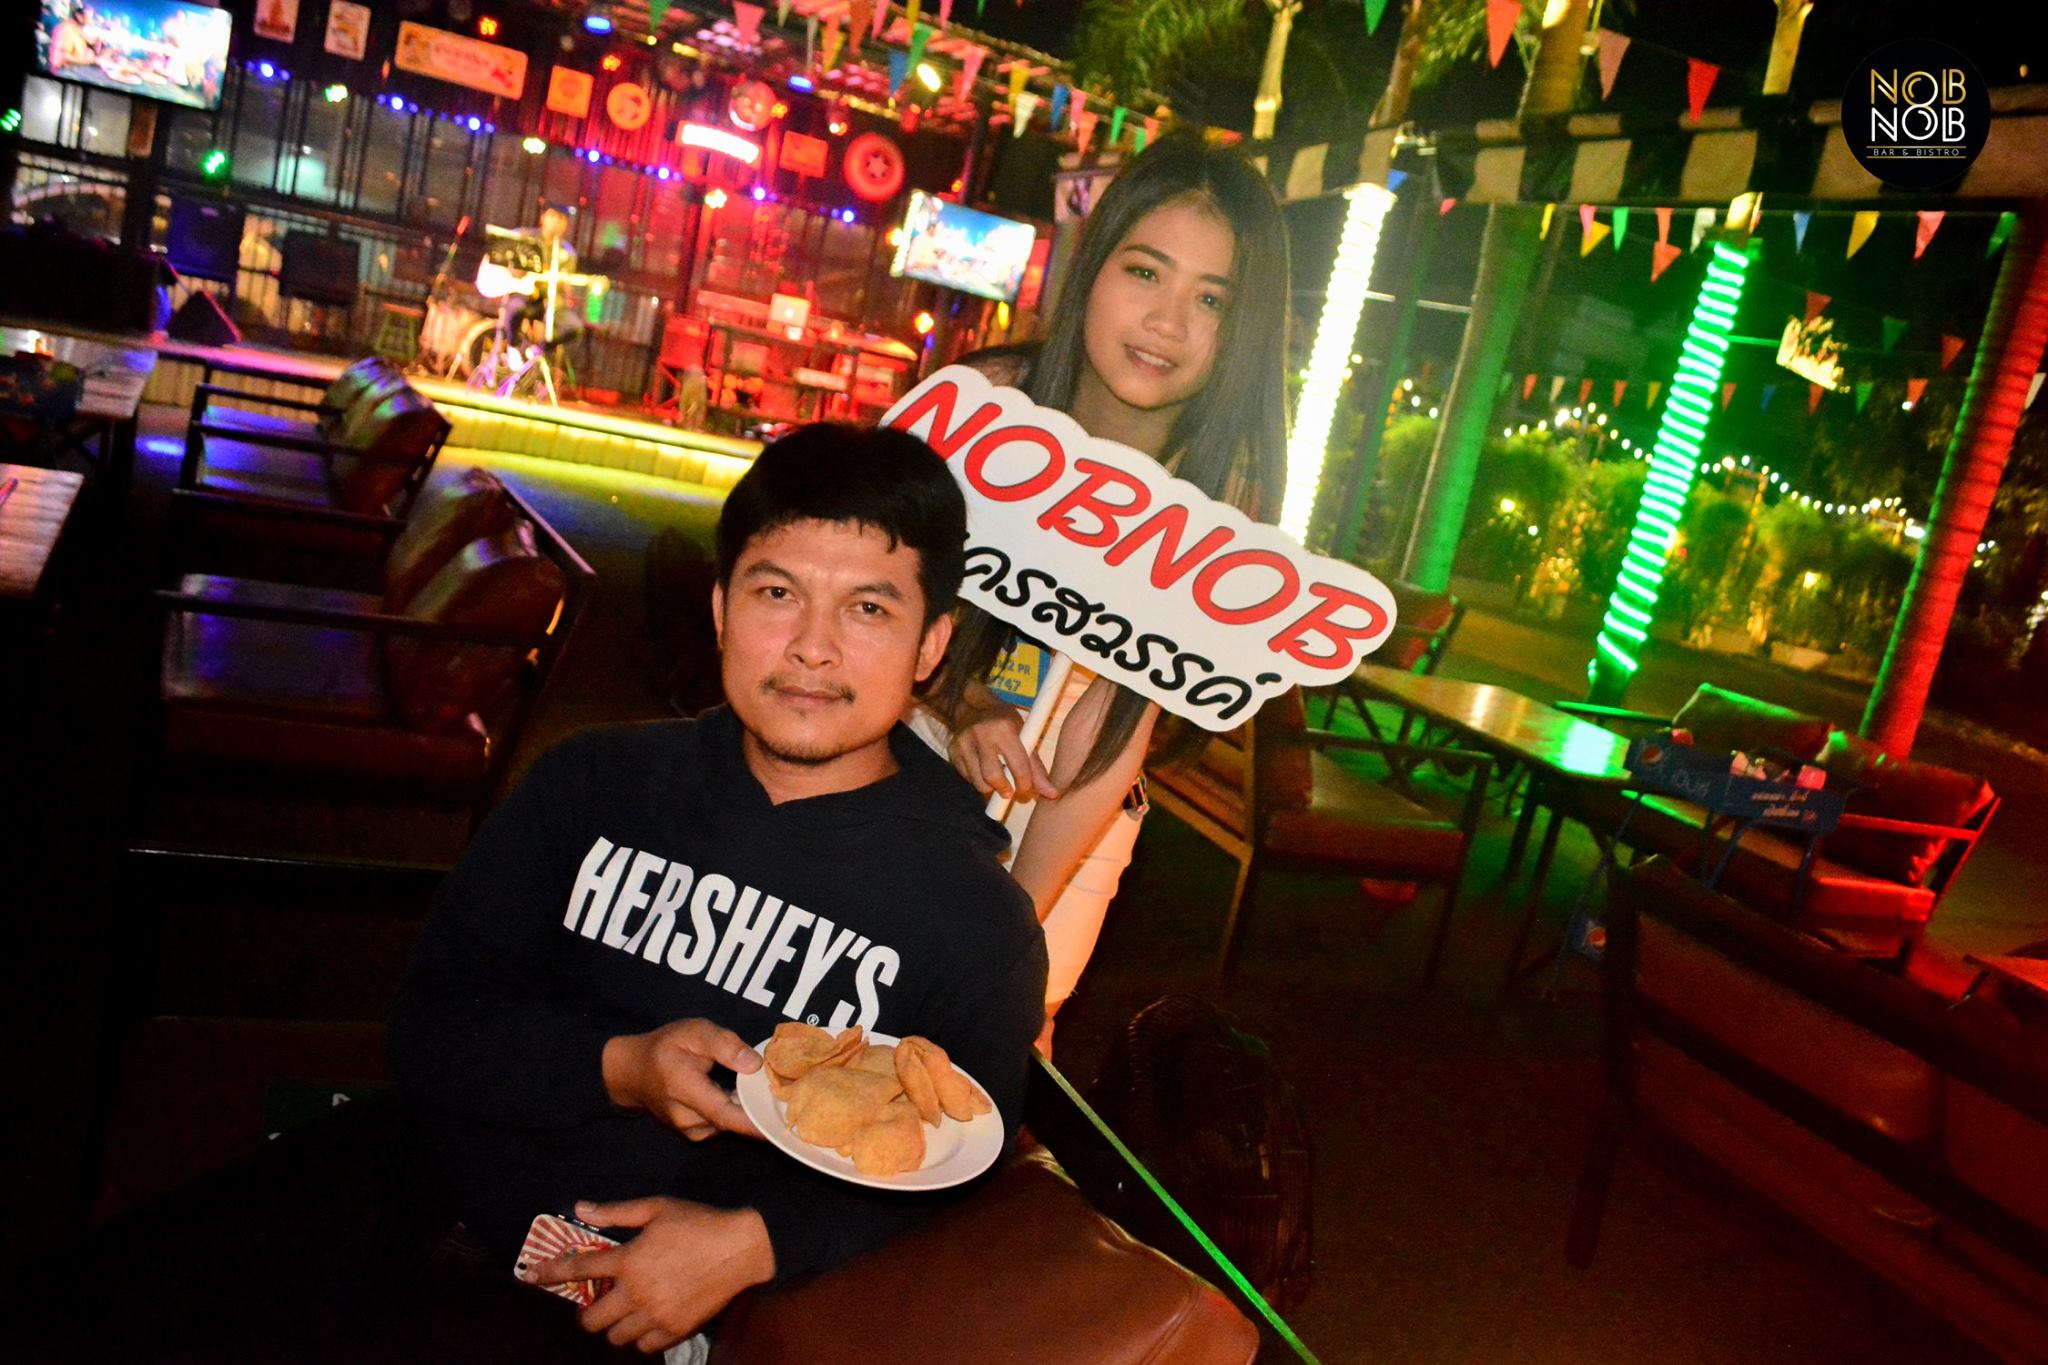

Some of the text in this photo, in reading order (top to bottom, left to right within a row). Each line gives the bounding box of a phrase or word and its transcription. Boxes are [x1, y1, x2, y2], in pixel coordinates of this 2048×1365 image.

[888, 380, 1389, 671] NOBNOB
[962, 532, 1283, 720] ครสวรรค์
[563, 836, 901, 1033] HERSHEY'S
